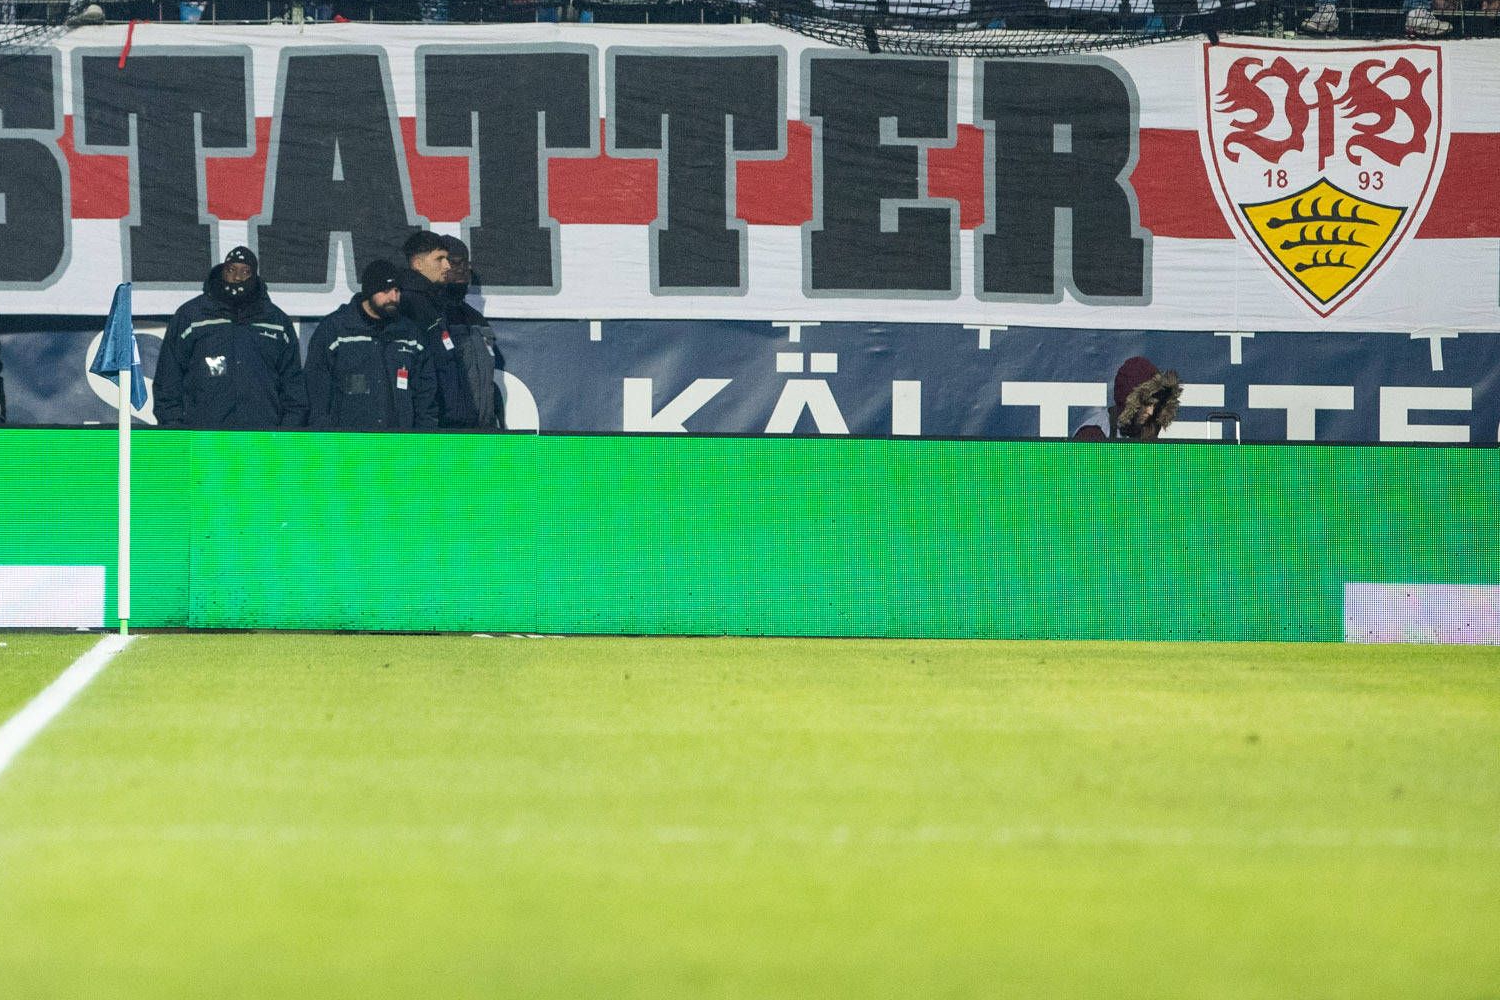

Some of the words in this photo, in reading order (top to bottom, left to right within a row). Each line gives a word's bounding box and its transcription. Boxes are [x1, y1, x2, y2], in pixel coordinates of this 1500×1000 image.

[1214, 55, 1433, 172] VfB
[1263, 169, 1289, 188] 18
[1358, 171, 1384, 190] 93
